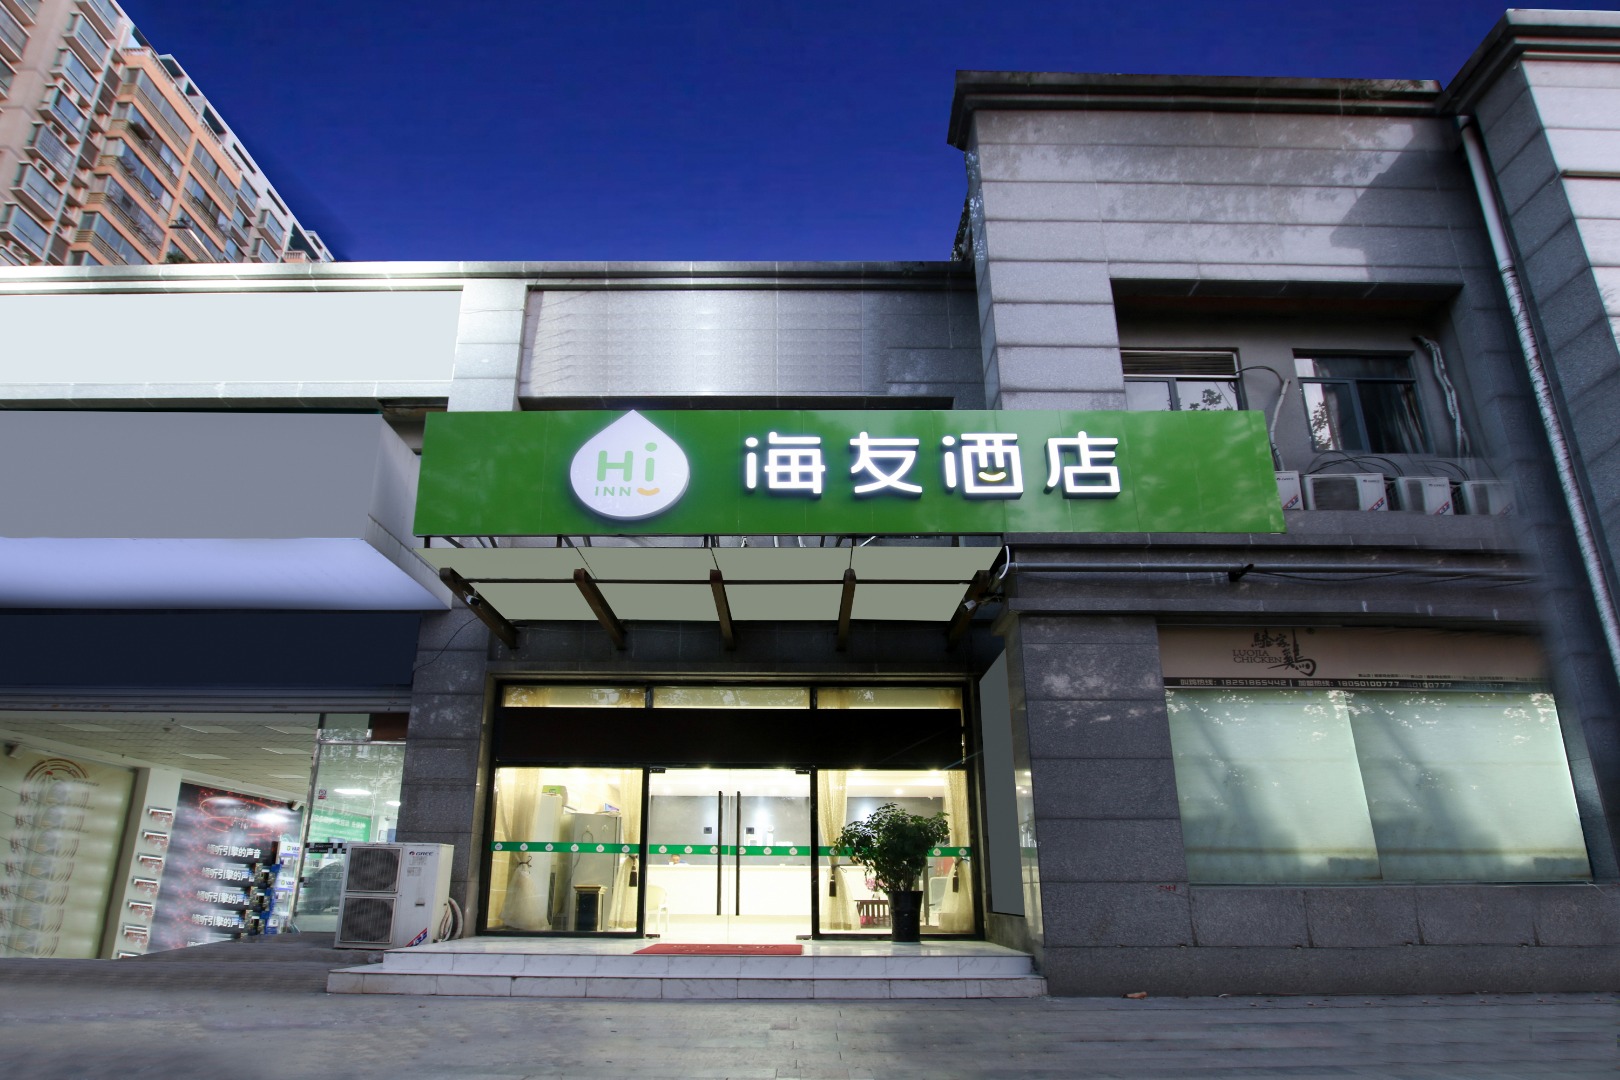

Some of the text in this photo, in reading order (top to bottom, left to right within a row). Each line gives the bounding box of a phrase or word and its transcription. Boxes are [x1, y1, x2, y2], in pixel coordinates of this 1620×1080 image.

[596, 442, 658, 482] Hi
[744, 430, 1121, 496] 海友酒店
[594, 486, 632, 497] INN
[1232, 649, 1270, 657] LUOJIA
[1233, 656, 1282, 664] CHICKEN
